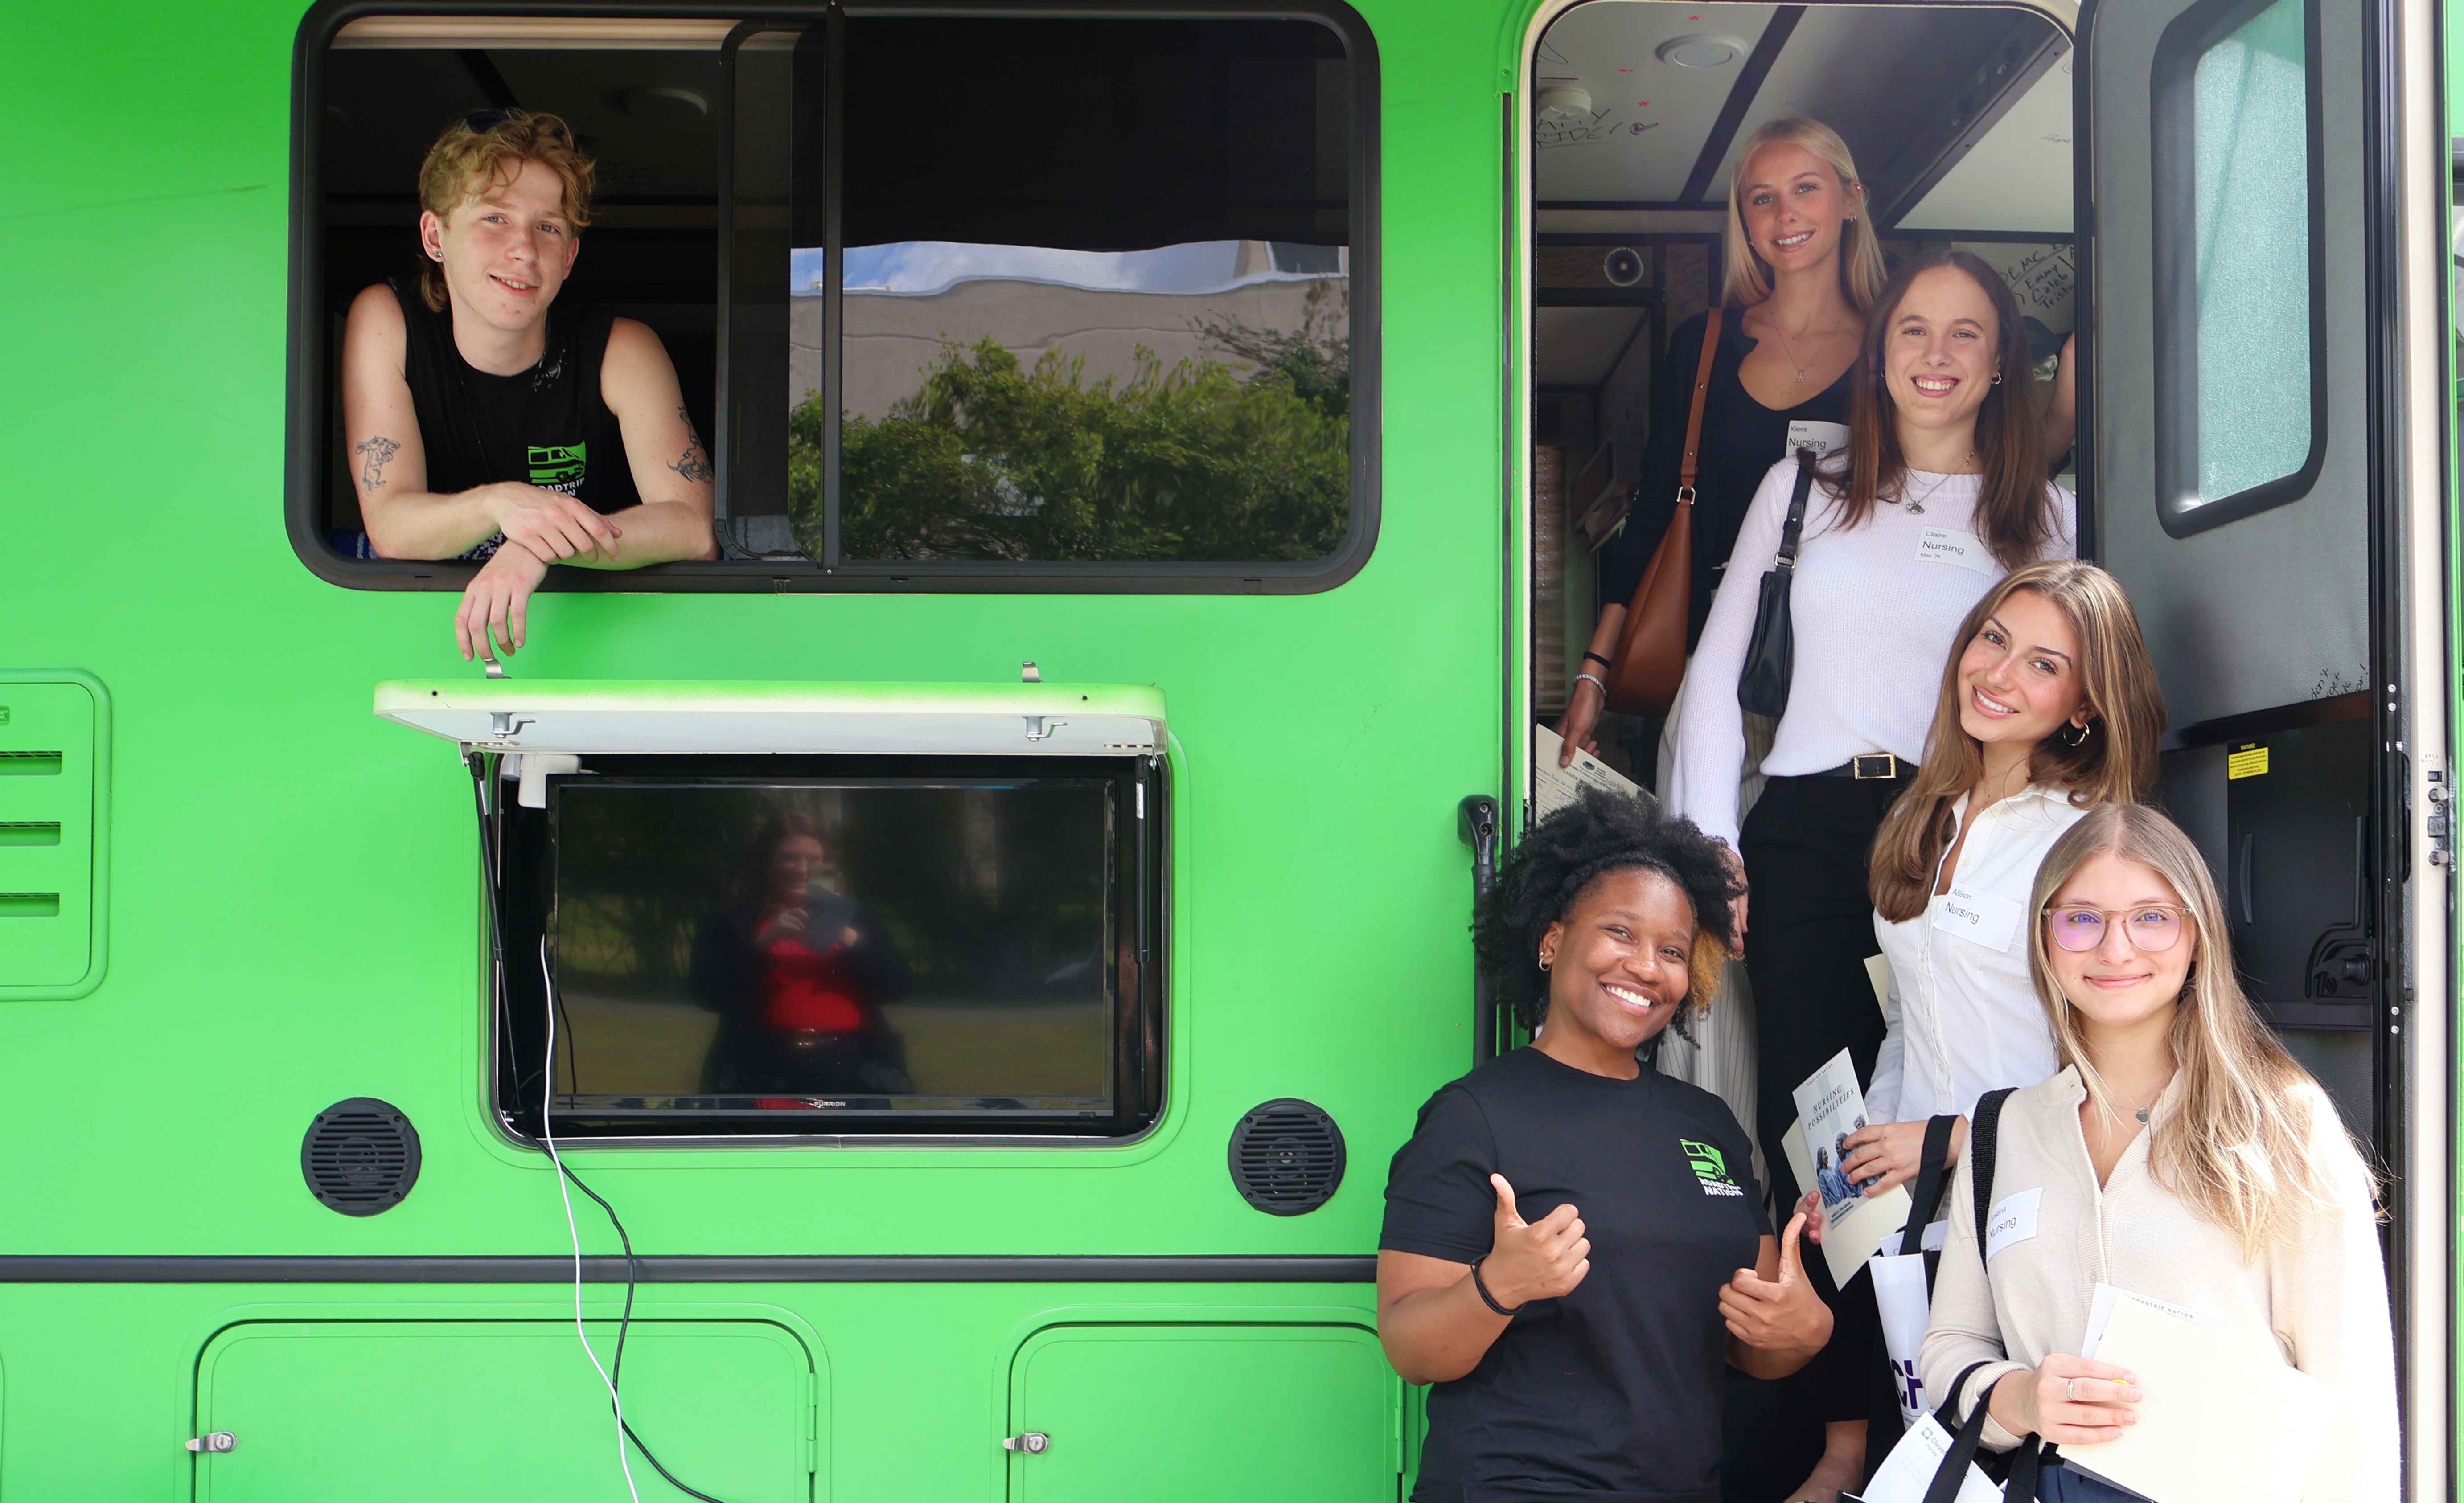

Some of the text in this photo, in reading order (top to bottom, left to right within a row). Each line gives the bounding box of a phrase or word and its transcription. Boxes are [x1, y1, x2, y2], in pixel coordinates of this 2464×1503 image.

[2032, 274, 2068, 303] Caleb
[1788, 437, 1826, 450] Nursing
[538, 477, 585, 492] ADTRIP
[1922, 541, 1964, 555] Nursing
[1952, 889, 1972, 901] Allison
[1945, 902, 1980, 925] Nursing
[1813, 1085, 1841, 1114] NURSING
[1808, 1088, 1854, 1130] POSSIBILITIES
[1703, 1186, 1744, 1196] NATION
[1989, 1217, 2016, 1241] Nursing
[2168, 1308, 2193, 1319] NATION
